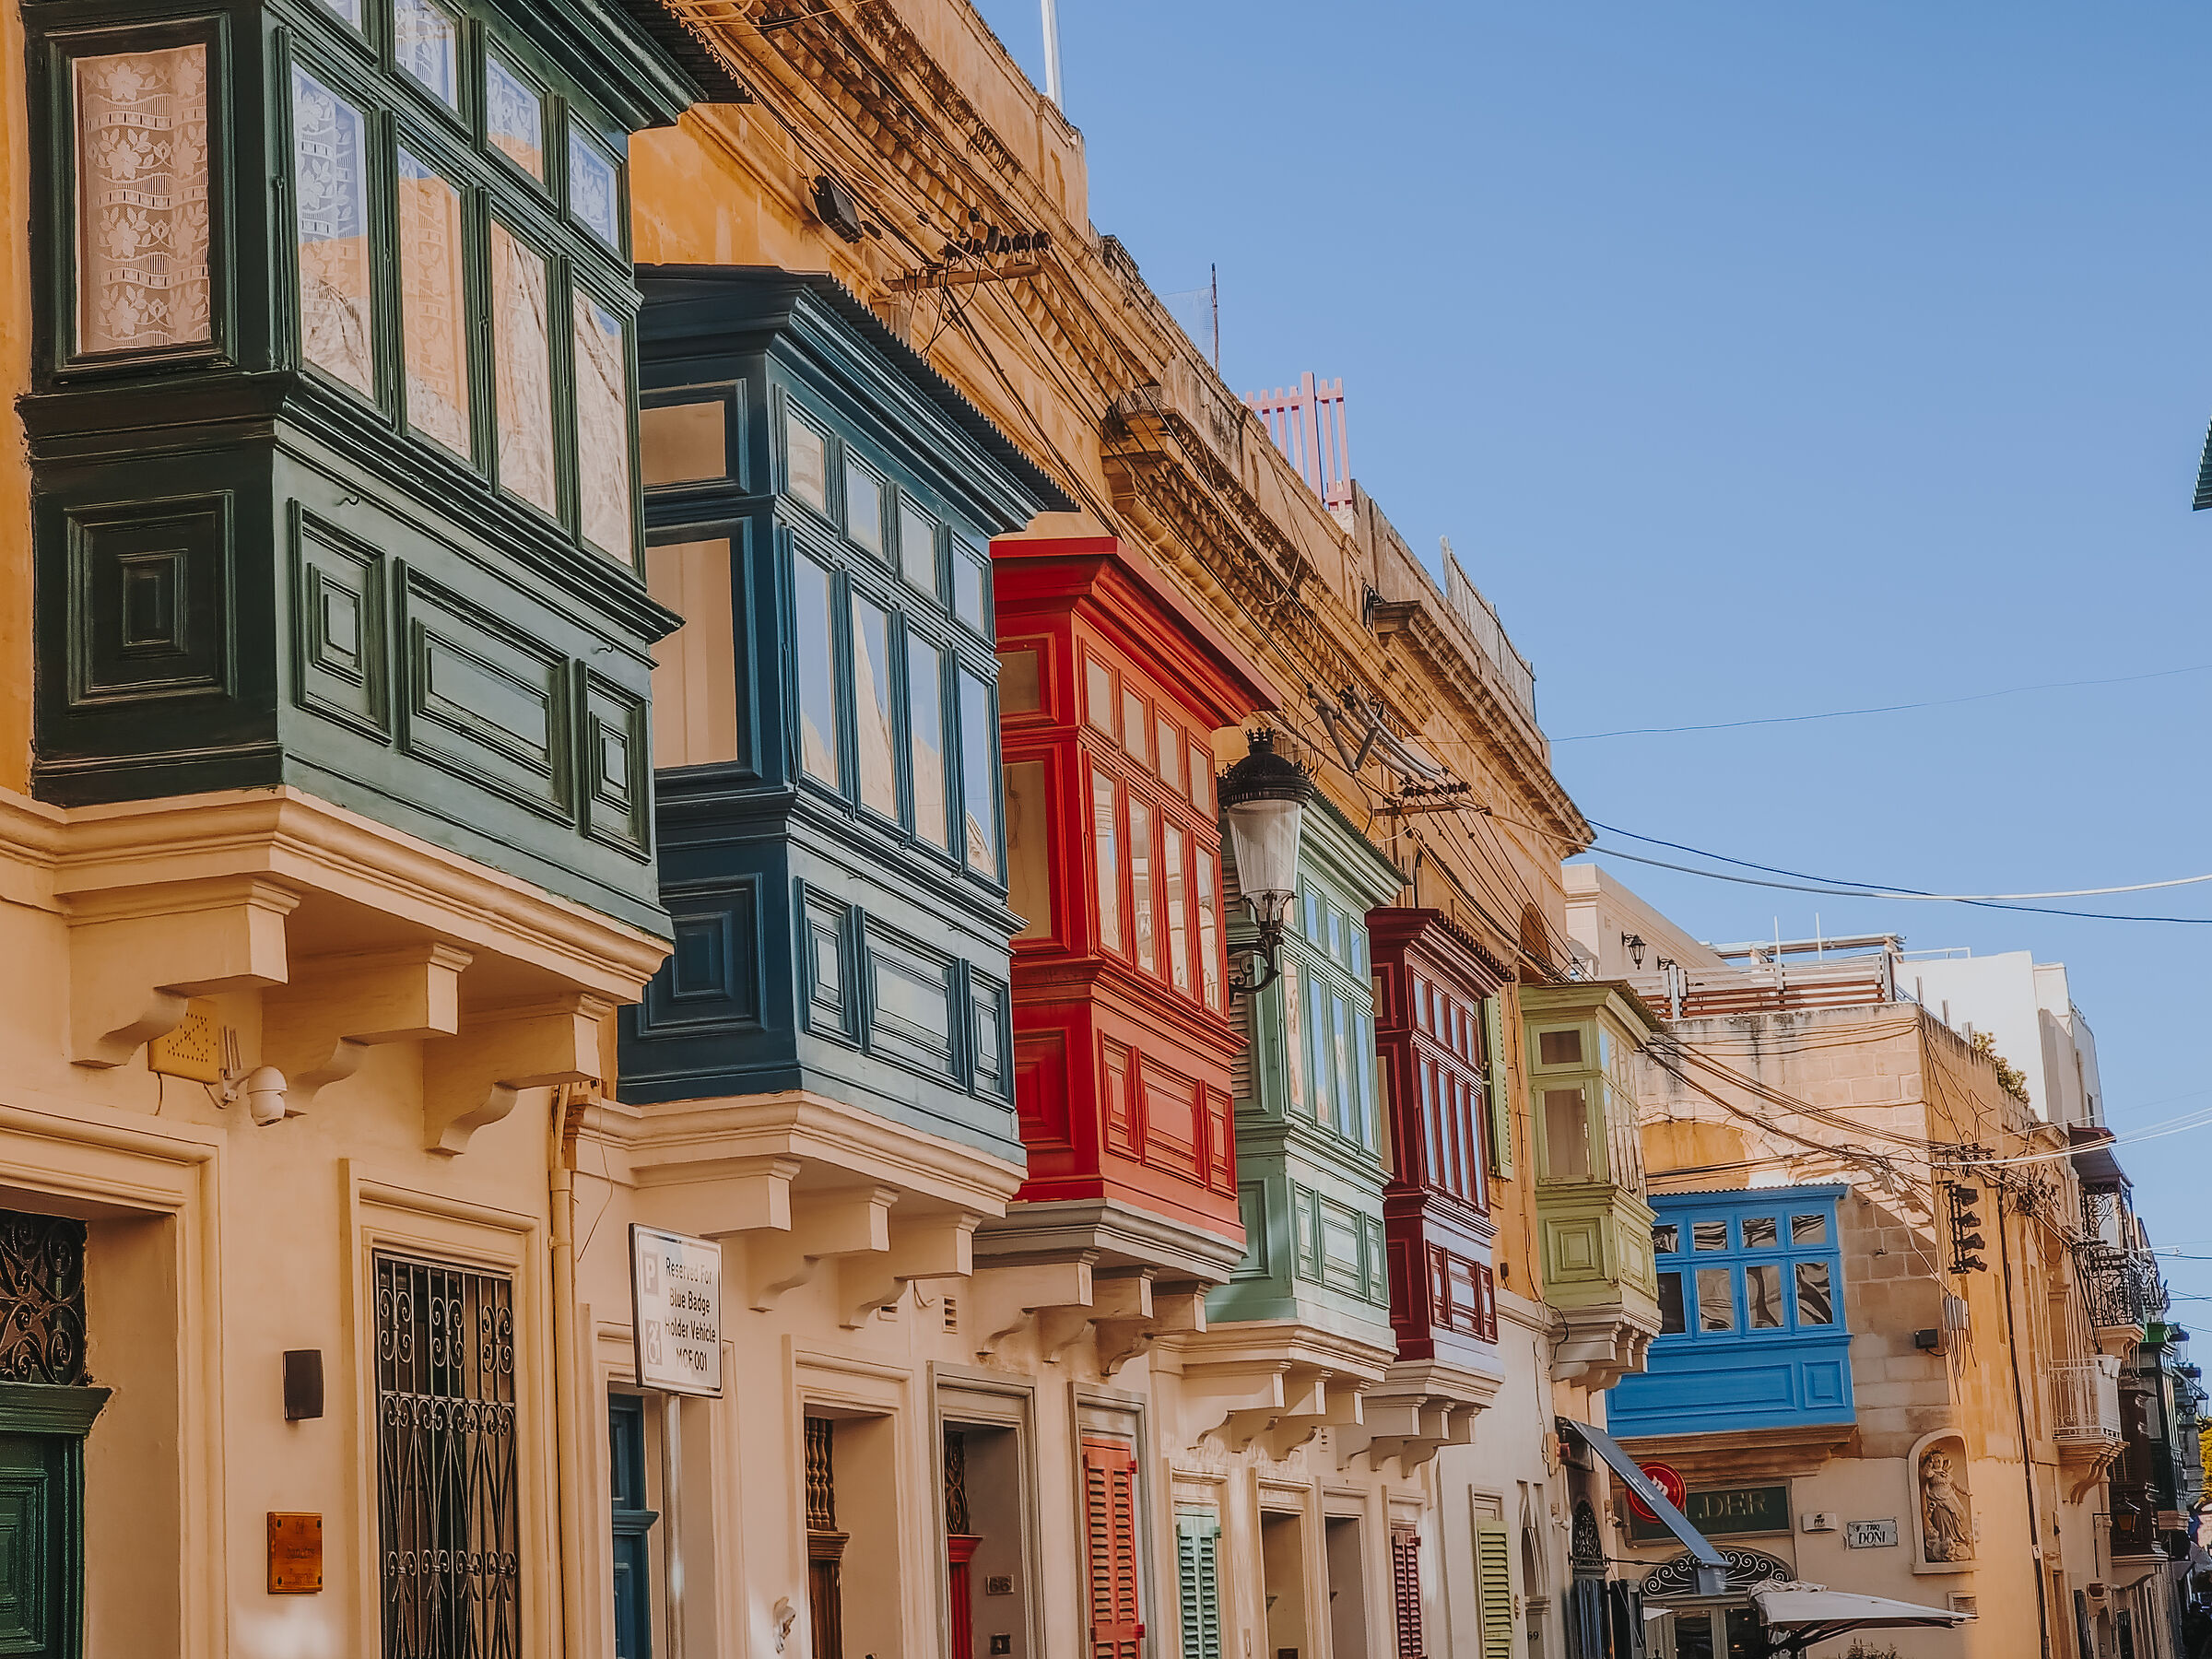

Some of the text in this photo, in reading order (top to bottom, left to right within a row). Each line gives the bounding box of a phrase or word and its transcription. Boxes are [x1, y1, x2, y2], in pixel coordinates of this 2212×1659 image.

[665, 1257, 712, 1285] Reserved For
[669, 1288, 710, 1316] Blue Badge
[665, 1315, 716, 1343] Holder Vehicle
[694, 1350, 708, 1371] 001
[1858, 1531, 1886, 1544] DONI
